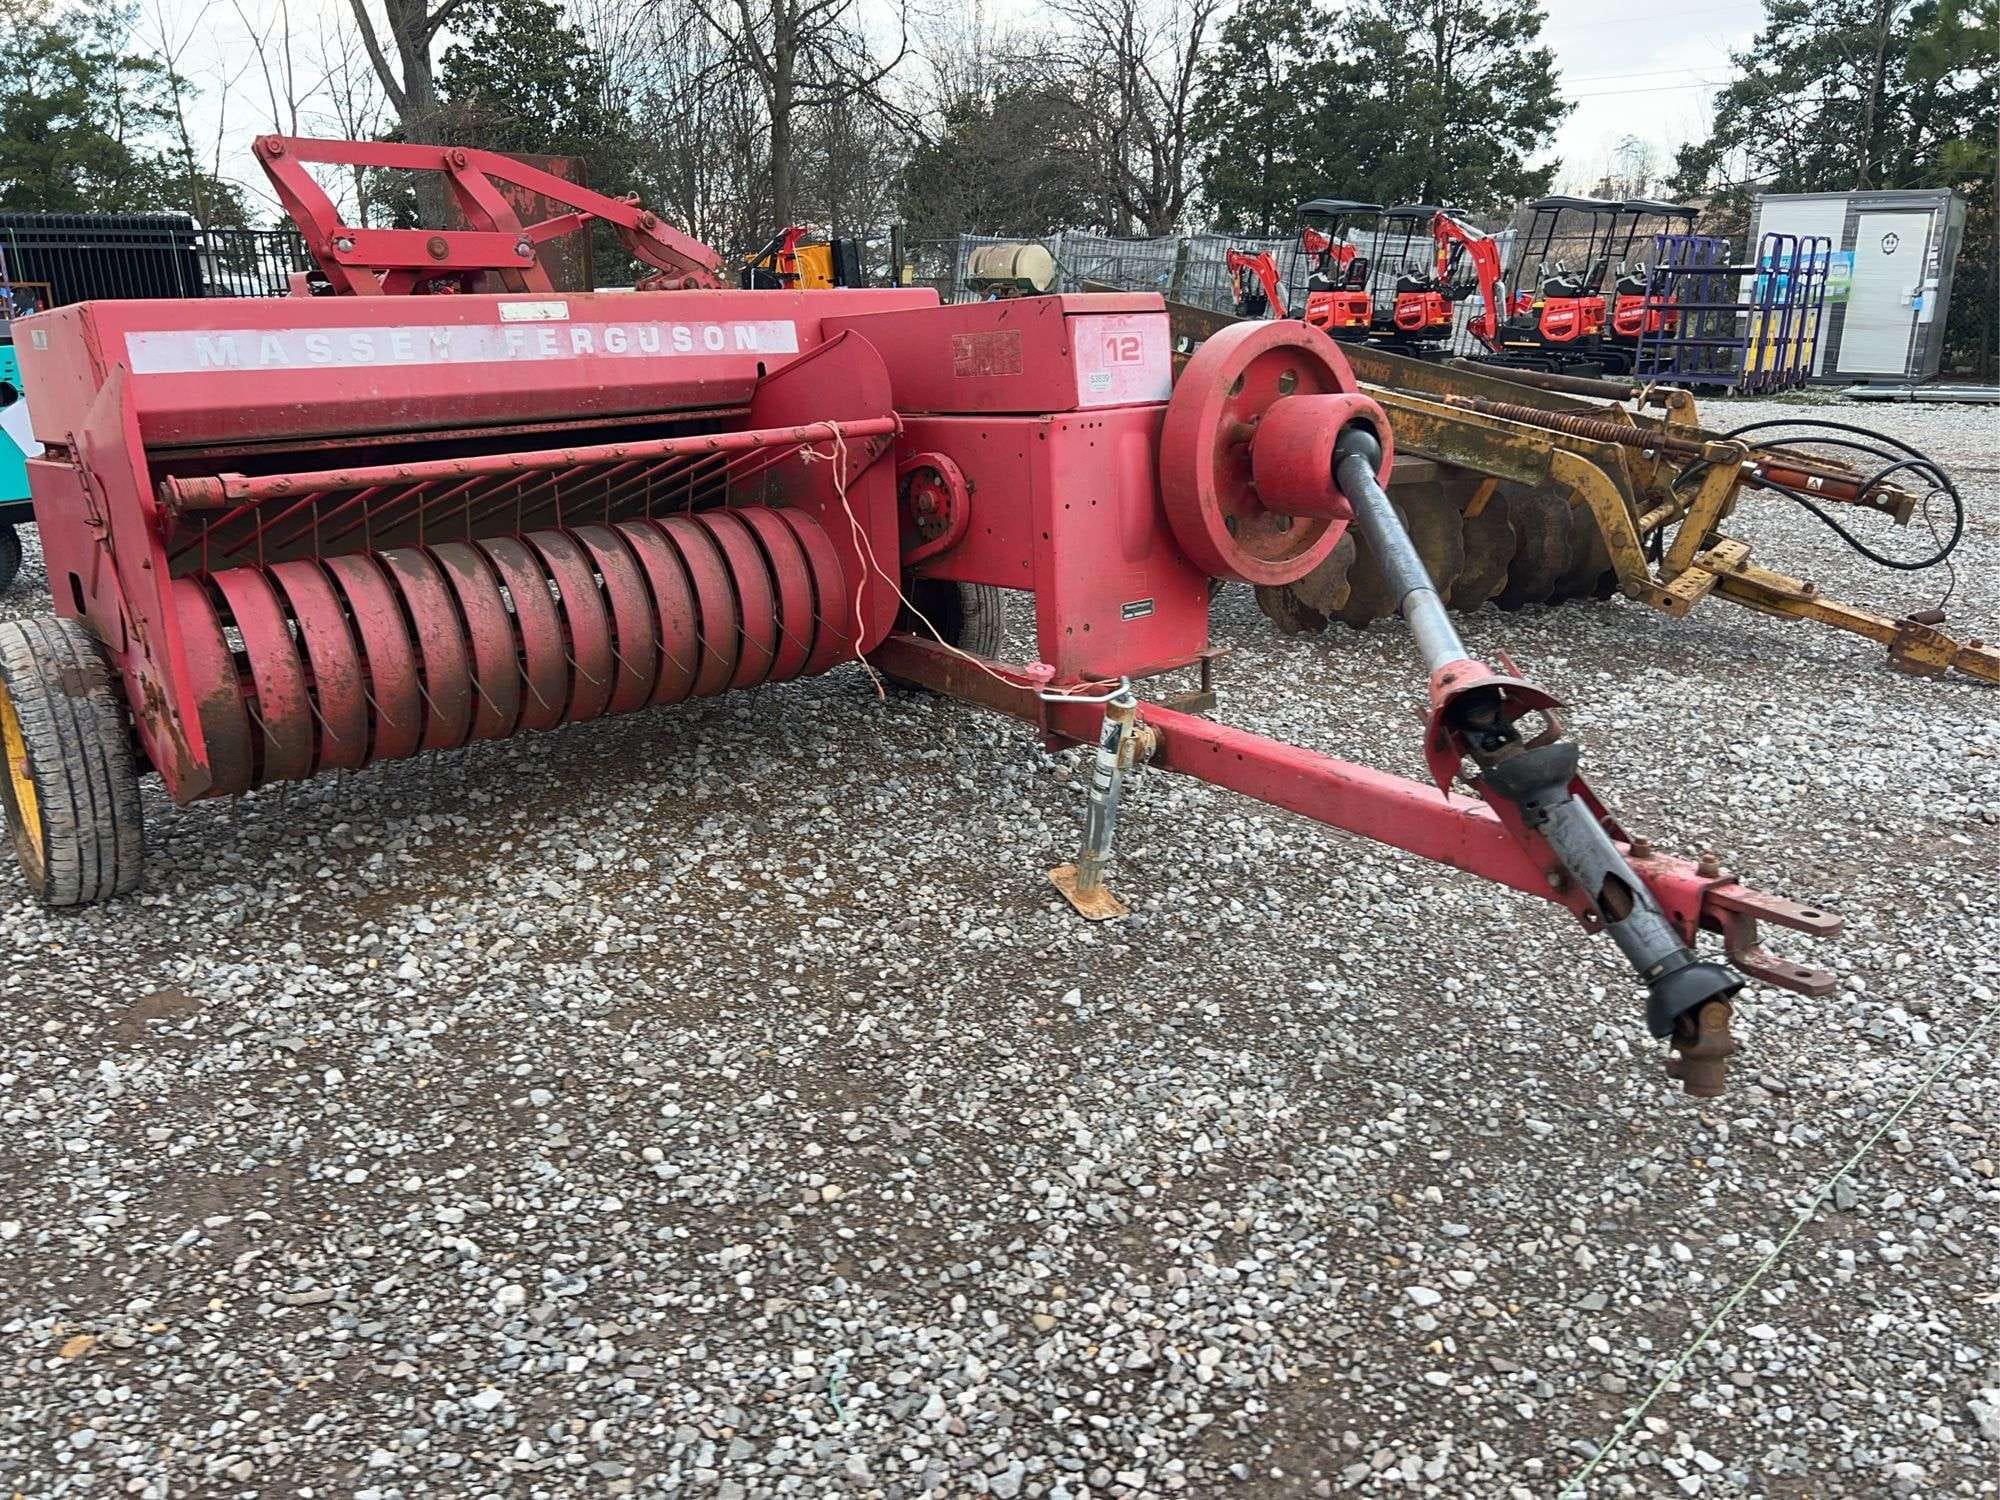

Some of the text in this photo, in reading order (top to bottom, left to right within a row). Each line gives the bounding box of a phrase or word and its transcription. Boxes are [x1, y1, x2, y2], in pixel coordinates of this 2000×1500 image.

[194, 325, 758, 368] MASSEY FERGUSON
[1106, 336, 1140, 362] 12
